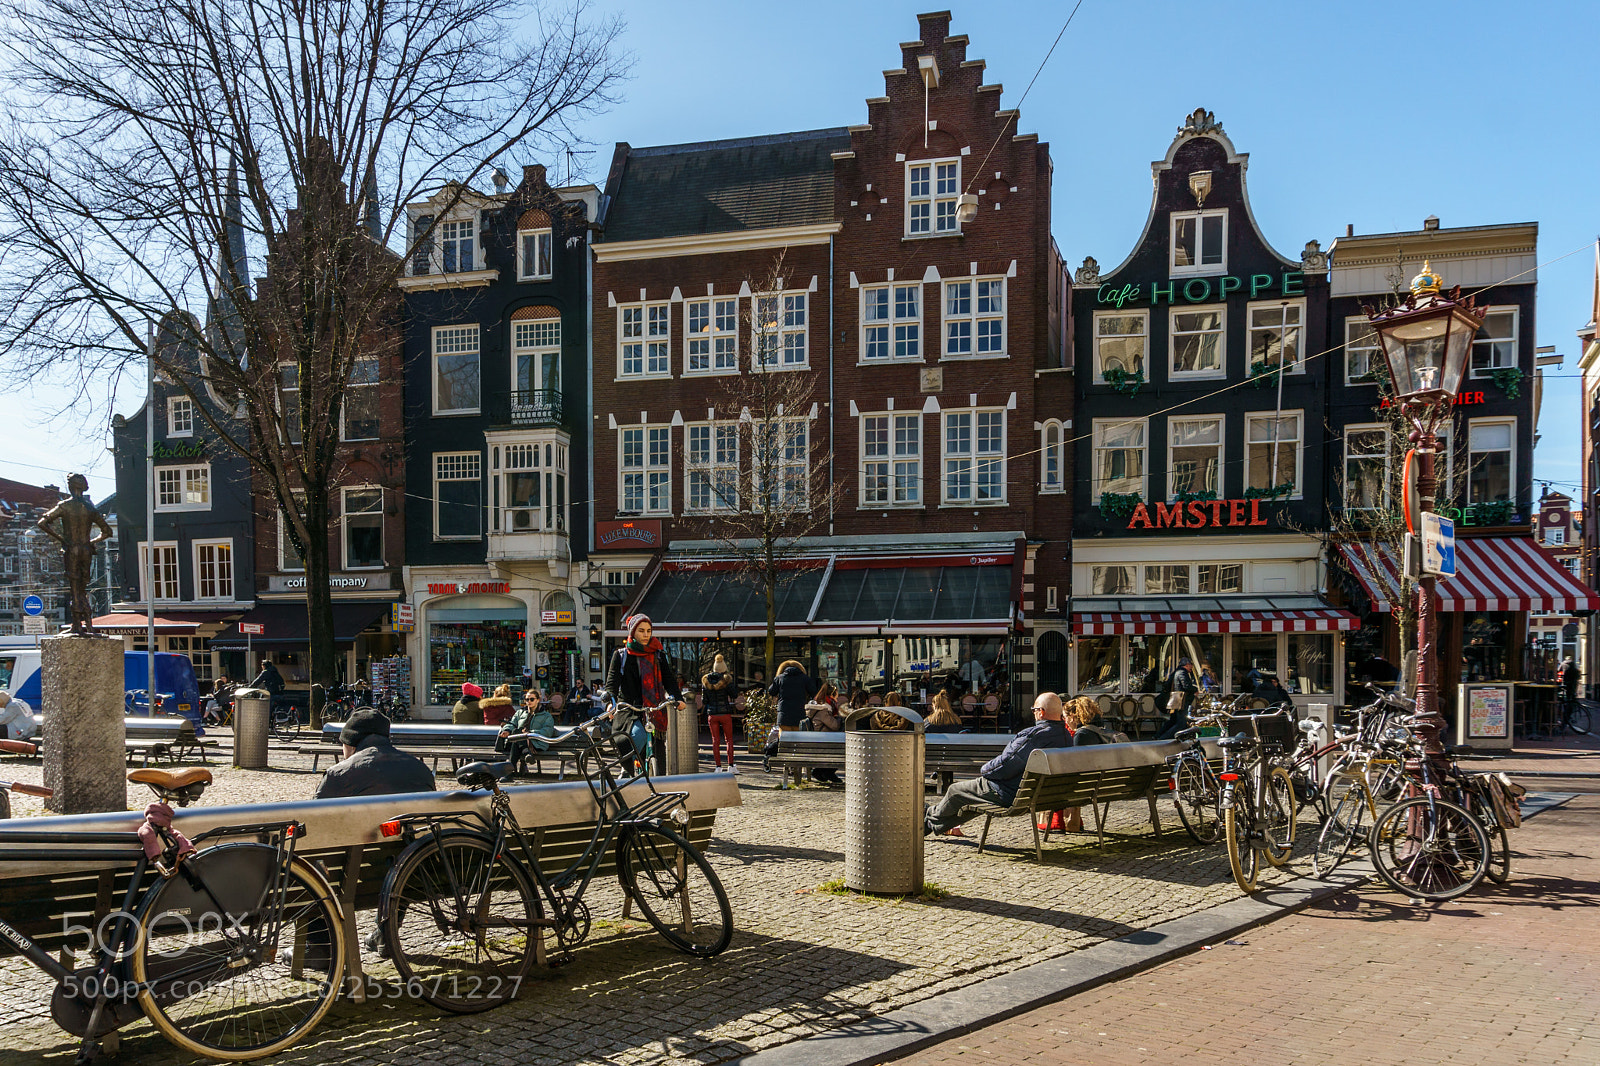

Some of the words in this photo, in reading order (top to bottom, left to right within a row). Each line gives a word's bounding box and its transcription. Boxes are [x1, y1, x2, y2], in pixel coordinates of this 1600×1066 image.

[1098, 283, 1140, 308] Café
[1151, 271, 1306, 304] HOPPE
[1125, 498, 1268, 529] AMSTEL
[600, 528, 657, 544] LUXEMBOURG
[287, 577, 367, 588] coffmpany
[427, 583, 457, 594] TABAK
[467, 582, 511, 594] SMOKING
[1296, 643, 1326, 664] Hoppe
